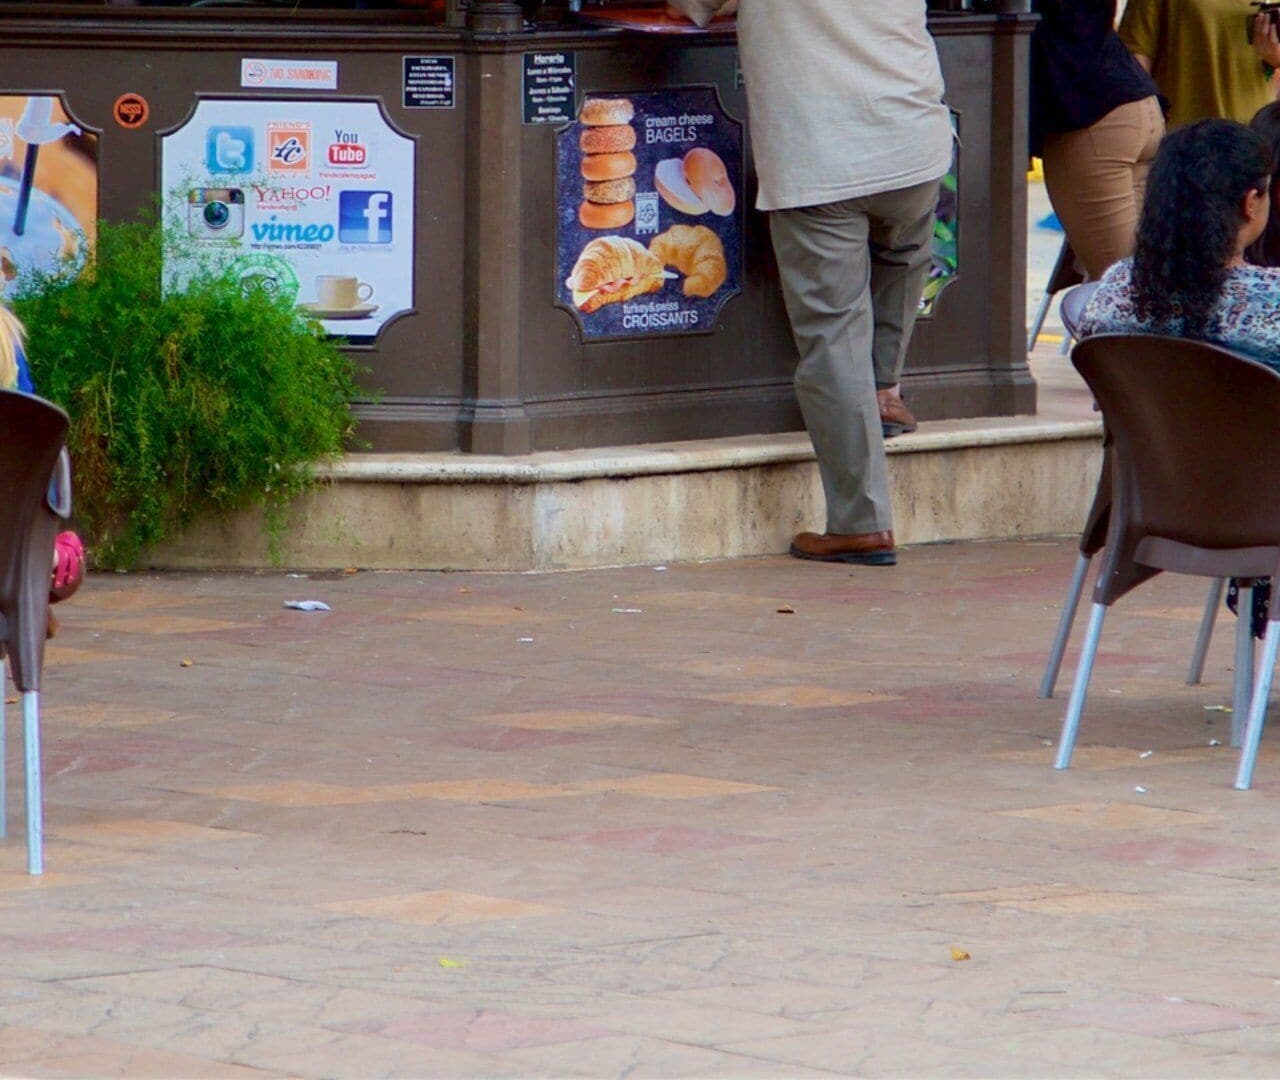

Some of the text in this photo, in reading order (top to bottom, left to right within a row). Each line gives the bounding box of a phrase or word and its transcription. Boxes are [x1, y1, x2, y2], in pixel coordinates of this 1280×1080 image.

[270, 68, 332, 81] NO SMOKING
[645, 112, 714, 128] cream cheese
[335, 130, 358, 144] You
[645, 126, 698, 145] BAGELS
[331, 146, 364, 162] Tube
[255, 185, 331, 203] YAHOO!
[250, 216, 335, 242] vimeo
[622, 310, 699, 329] CROISSANTS
